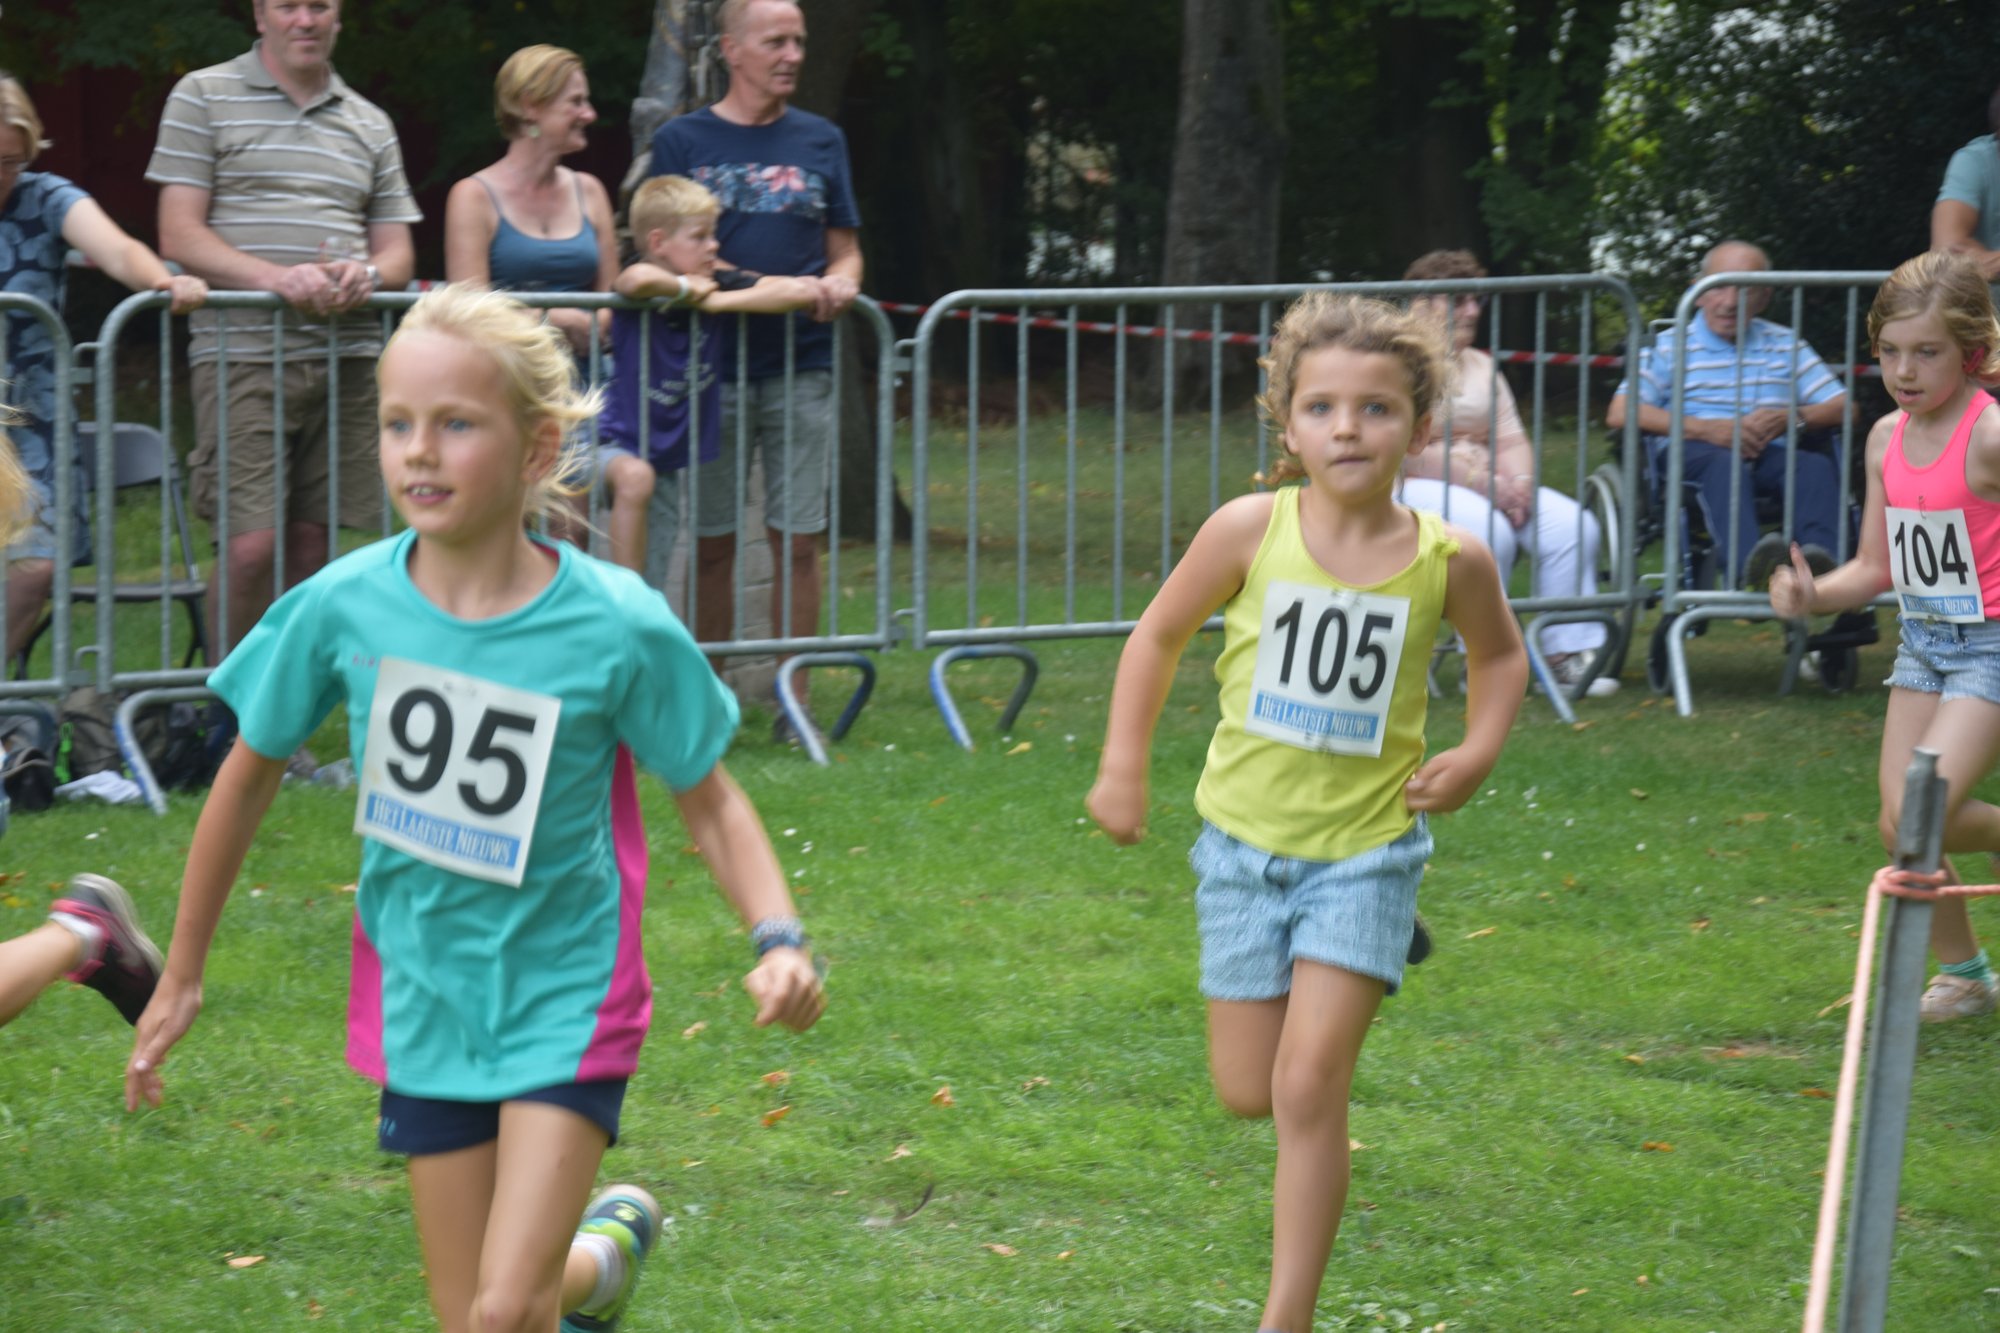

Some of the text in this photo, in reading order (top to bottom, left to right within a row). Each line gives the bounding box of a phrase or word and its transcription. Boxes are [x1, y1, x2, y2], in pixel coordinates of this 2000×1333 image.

[1895, 521, 1968, 587] 104
[1943, 597, 1975, 615] NIEUWS
[1274, 597, 1394, 702] 105
[1260, 693, 1285, 723] HET
[1281, 701, 1329, 733] LAATSTE
[386, 685, 537, 817] 95
[455, 824, 513, 866] NIEUWS
